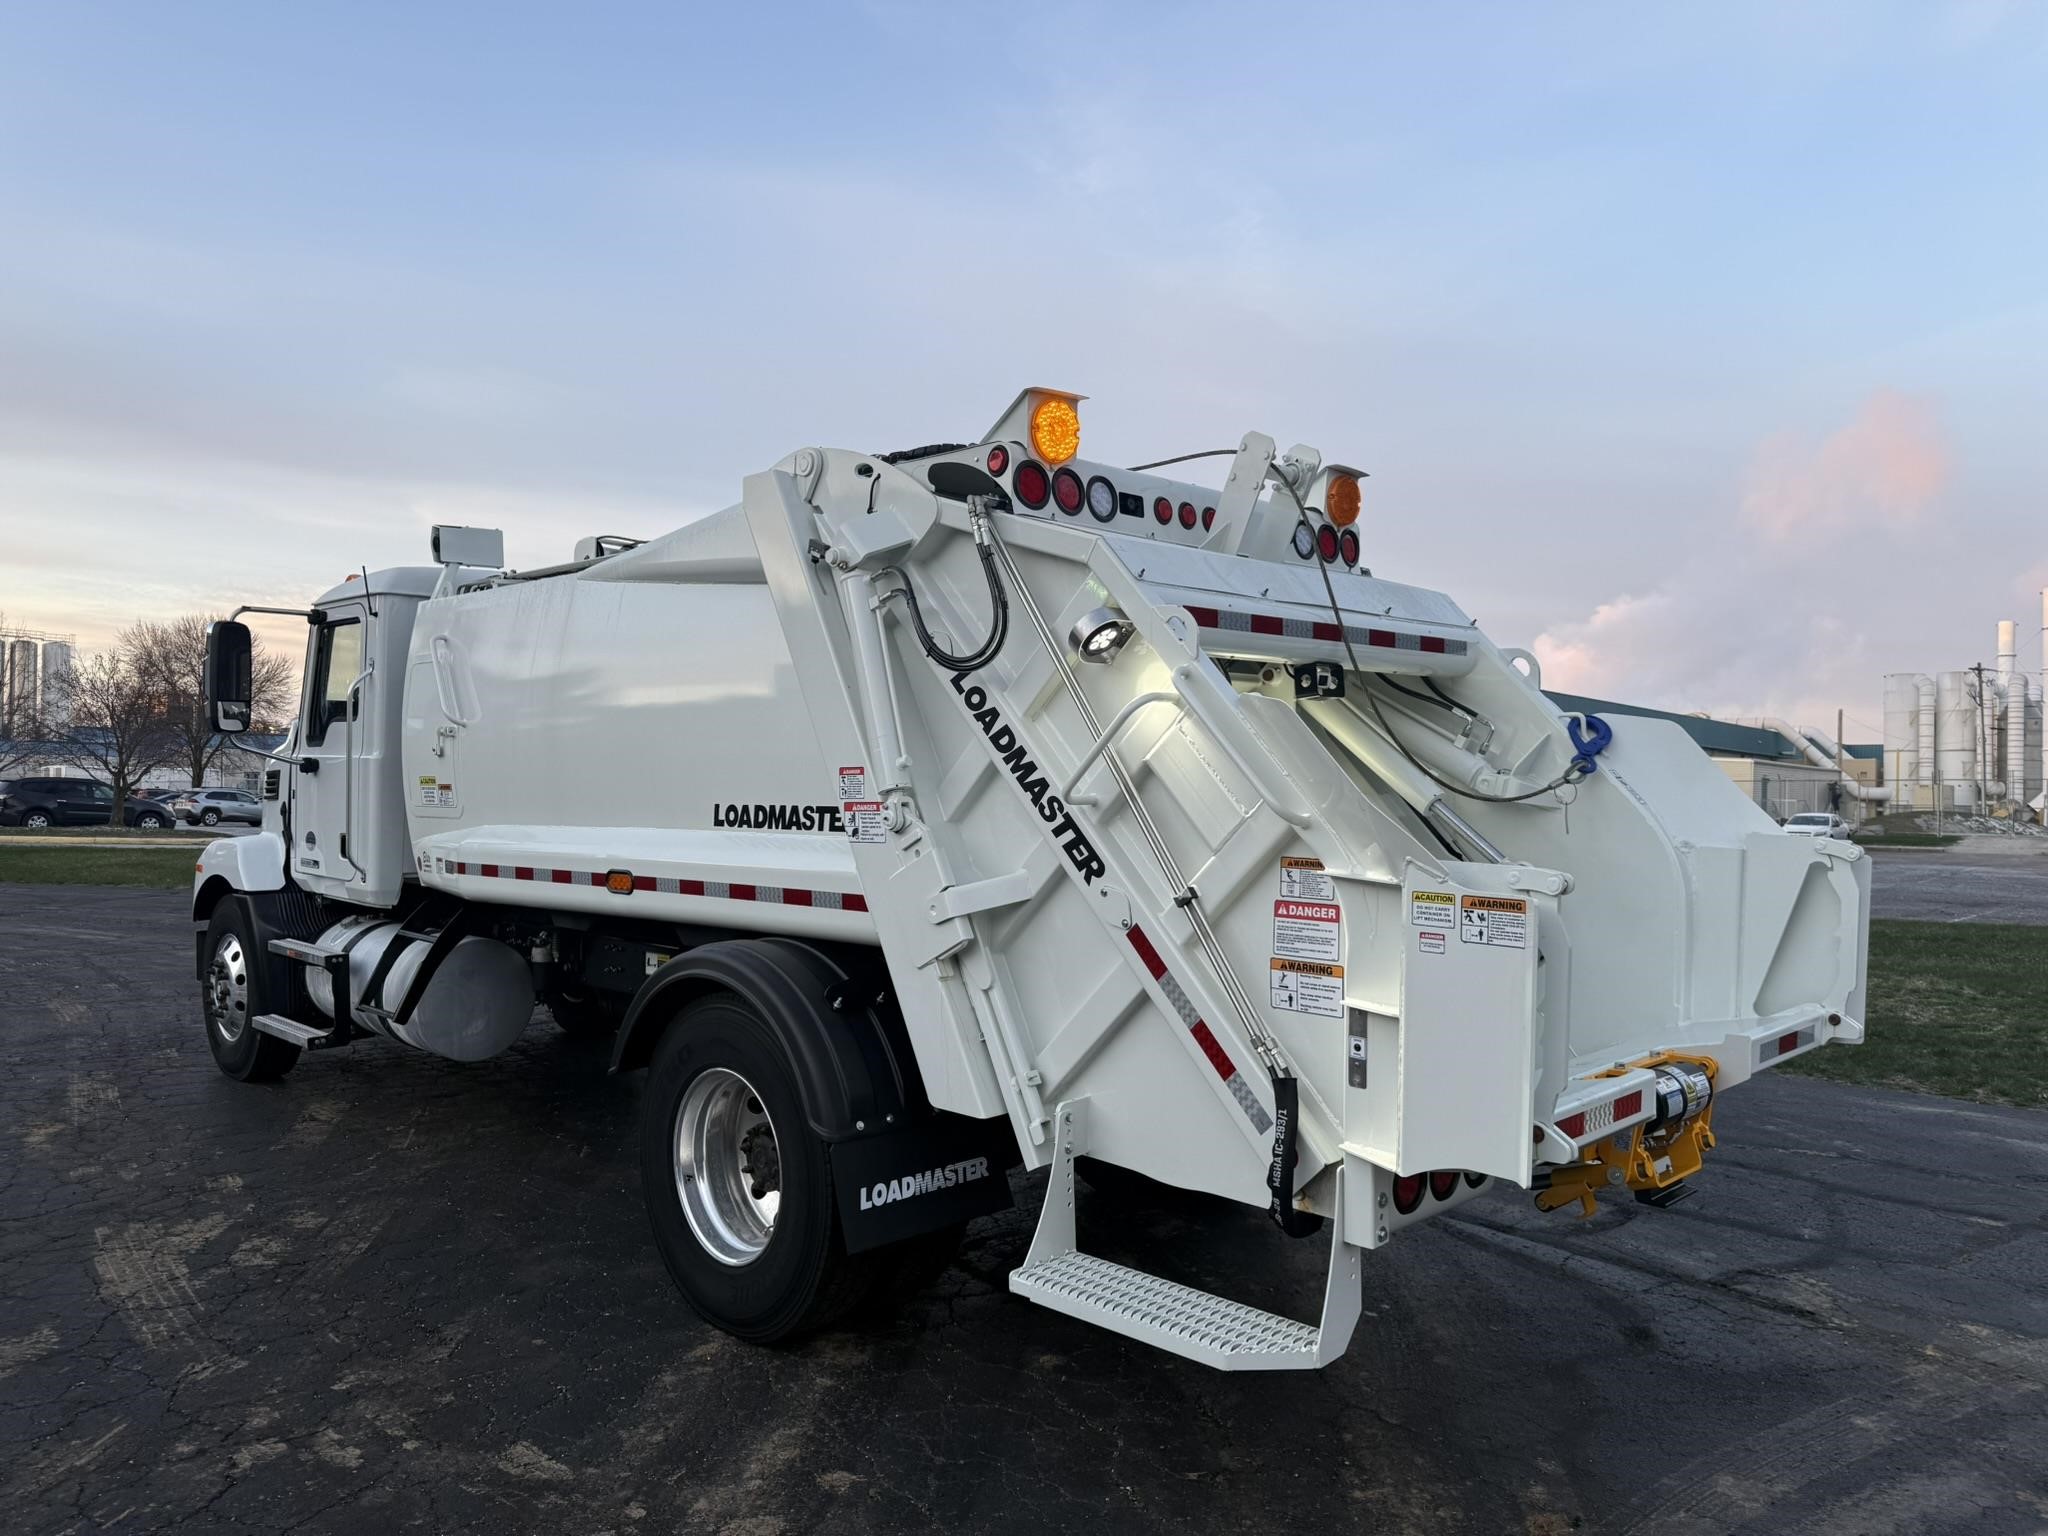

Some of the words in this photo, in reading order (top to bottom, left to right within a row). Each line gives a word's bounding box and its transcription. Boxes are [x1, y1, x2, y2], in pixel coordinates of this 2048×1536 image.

[950, 671, 1106, 887] LOADMASTER
[713, 803, 846, 833] LOADMASTE
[1294, 860, 1325, 870] WARNIN
[1420, 893, 1453, 904] CAUTION
[1480, 899, 1523, 911] WARNING
[1289, 905, 1336, 919] DANGER
[1287, 961, 1333, 975] WARNING
[1273, 1157, 1282, 1188] MSHA
[860, 1156, 989, 1211] LOADMASTER
